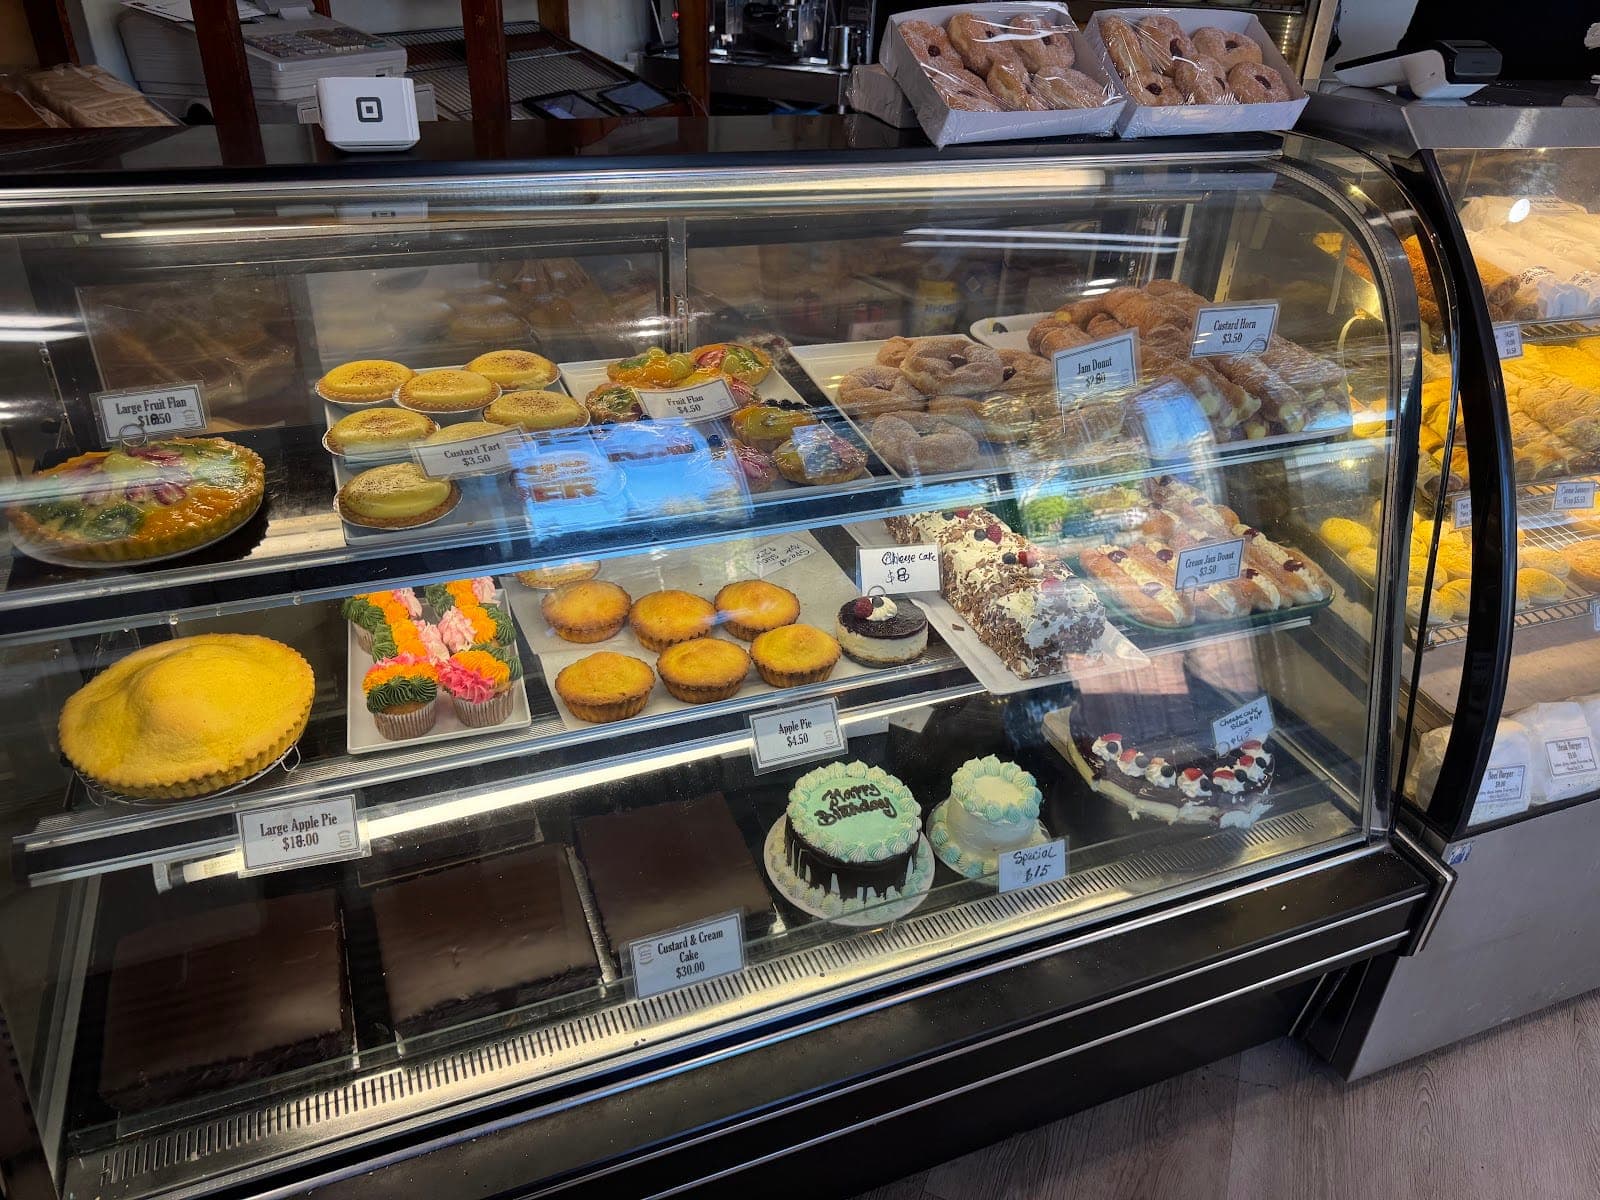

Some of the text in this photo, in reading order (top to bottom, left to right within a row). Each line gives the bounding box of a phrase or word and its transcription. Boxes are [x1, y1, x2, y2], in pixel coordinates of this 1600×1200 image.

[1213, 317, 1257, 332] Custard Horn
[1222, 332, 1243, 346] $3.50
[1078, 356, 1113, 375] Jam Donut
[116, 396, 187, 416] Large Fruit Flan
[665, 394, 704, 406] Fruit Flan
[677, 404, 701, 414] $4.50
[443, 442, 501, 459] Custard Tart
[462, 454, 491, 467] $3.50
[1185, 551, 1235, 569] Cream Jam Donut
[1199, 565, 1217, 577] $3.50
[778, 718, 812, 736] Apple Pie
[786, 732, 809, 748] $4.50
[821, 783, 882, 811] Happy
[260, 812, 338, 837] Large Apple Pie
[657, 936, 688, 955] Custard
[690, 934, 698, 946] &
[698, 929, 724, 943] Cream
[679, 950, 699, 963] Cake
[675, 961, 705, 980] $30.00
